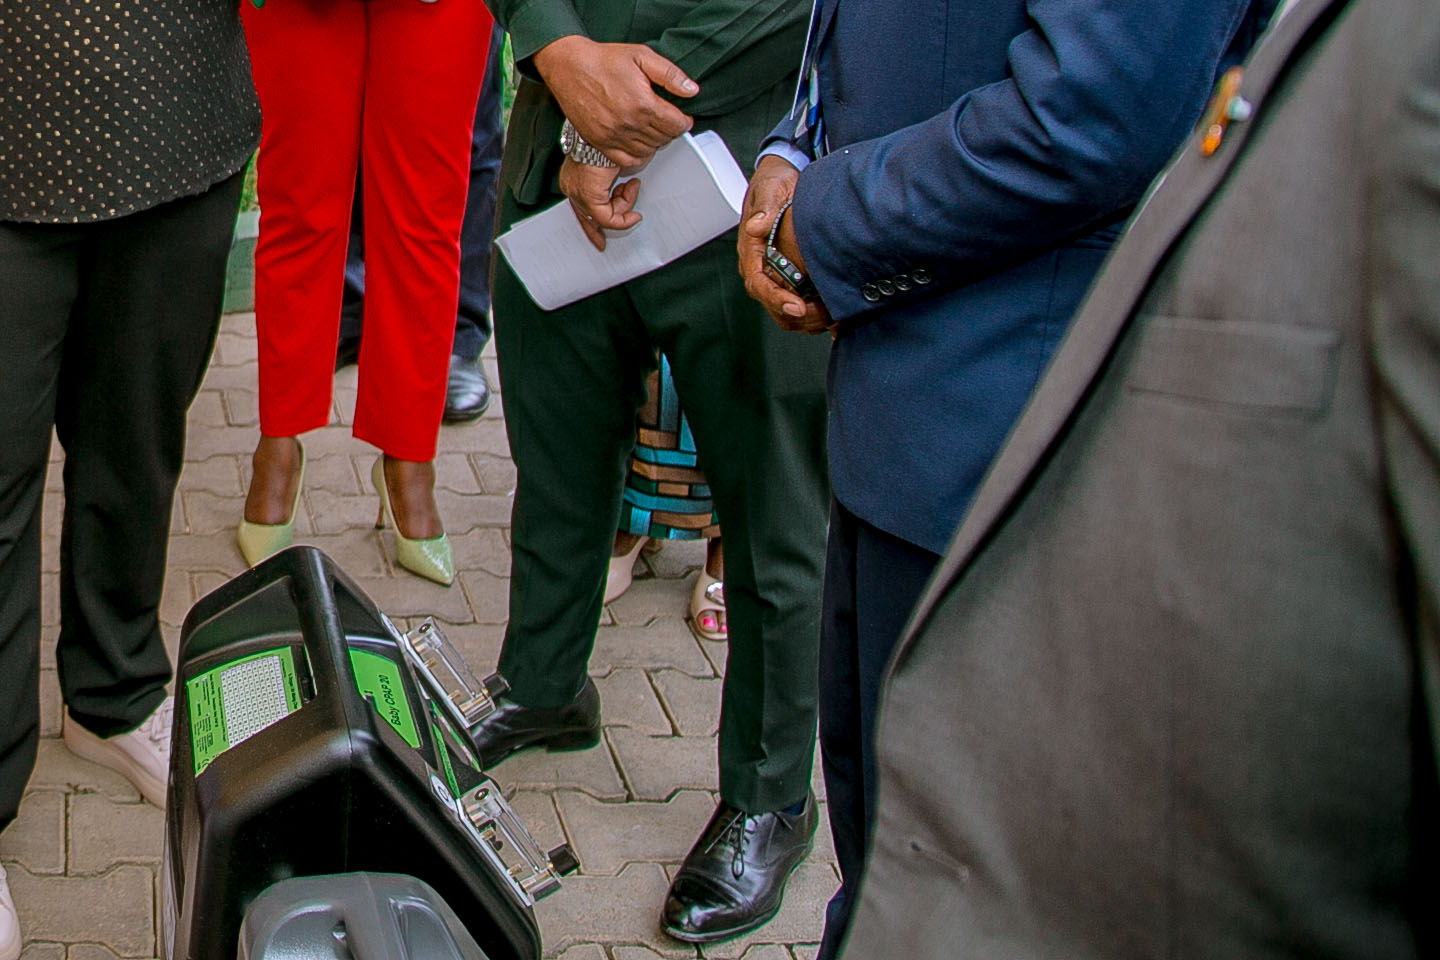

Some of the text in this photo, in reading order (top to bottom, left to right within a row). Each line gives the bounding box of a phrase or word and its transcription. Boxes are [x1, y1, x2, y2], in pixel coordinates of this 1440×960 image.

[378, 674, 402, 726] Baby CPAP 20
